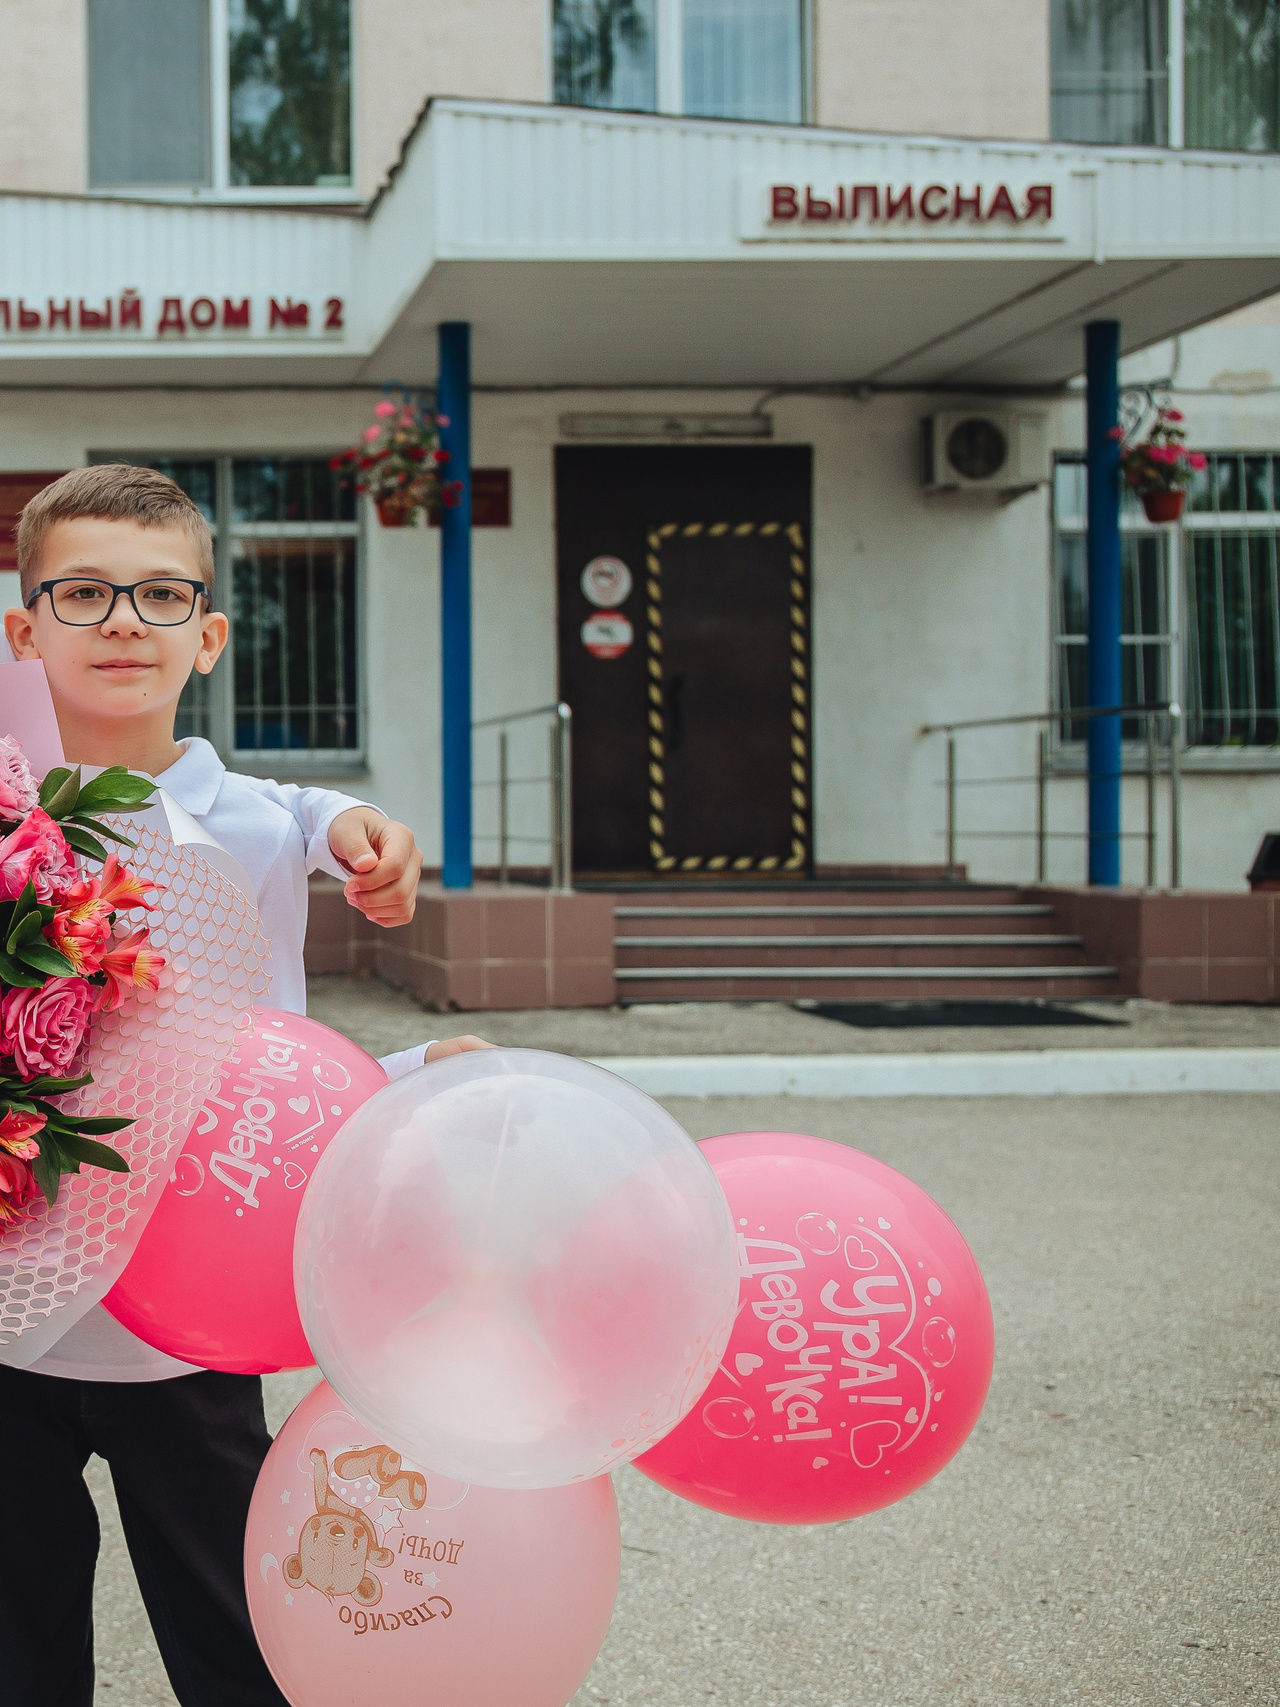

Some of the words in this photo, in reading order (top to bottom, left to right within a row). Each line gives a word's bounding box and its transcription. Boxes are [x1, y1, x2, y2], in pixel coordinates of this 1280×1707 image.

[771, 183, 1053, 220] ВЫПИСНАЯ
[157, 297, 250, 334] ДОМ
[269, 297, 308, 330] №
[324, 297, 344, 329] 2
[403, 1568, 424, 1587] за
[338, 1595, 453, 1636] Спасибо
